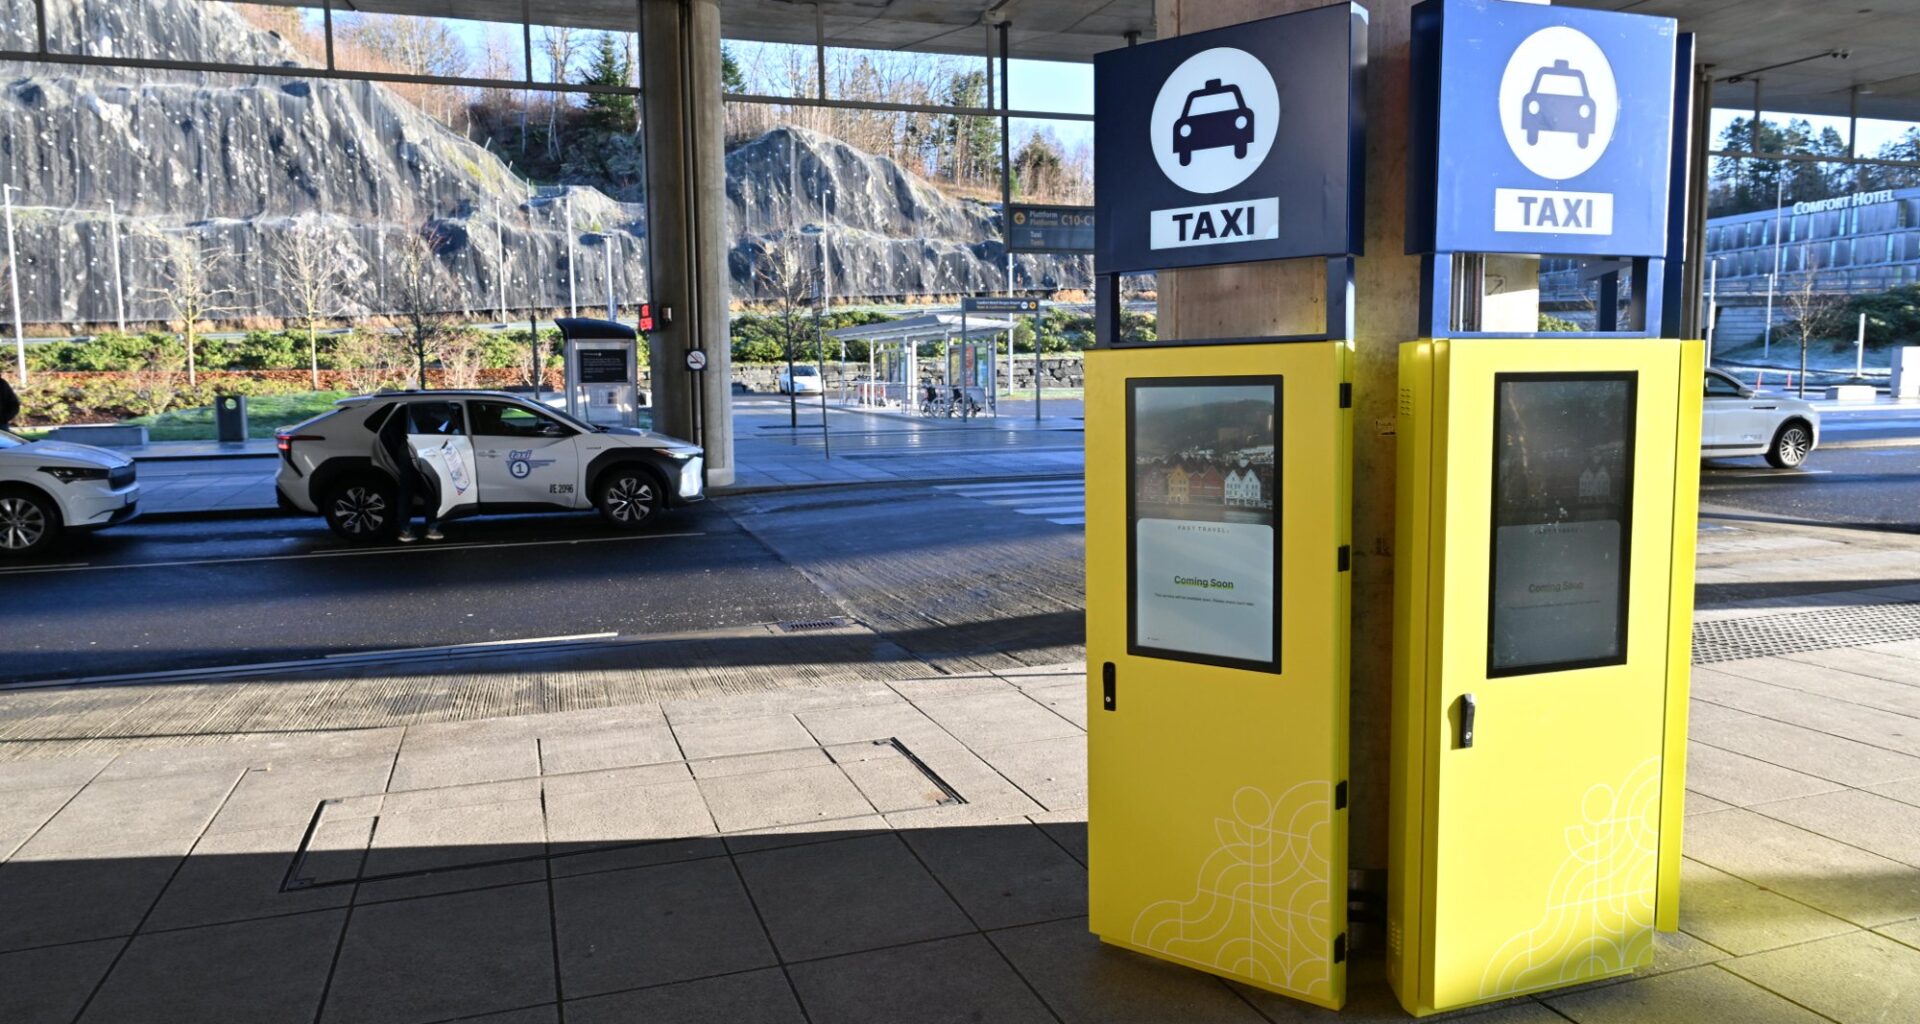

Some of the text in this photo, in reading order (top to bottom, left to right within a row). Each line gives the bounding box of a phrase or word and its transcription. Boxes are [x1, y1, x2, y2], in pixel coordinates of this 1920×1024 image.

[1517, 196, 1593, 228] TAXI
[1792, 189, 1895, 215] COMFORT HOTEL
[1061, 213, 1095, 226] C10-C1
[1172, 206, 1255, 242] TAXI
[516, 463, 525, 474] 1
[1174, 575, 1234, 589] Coming Soon
